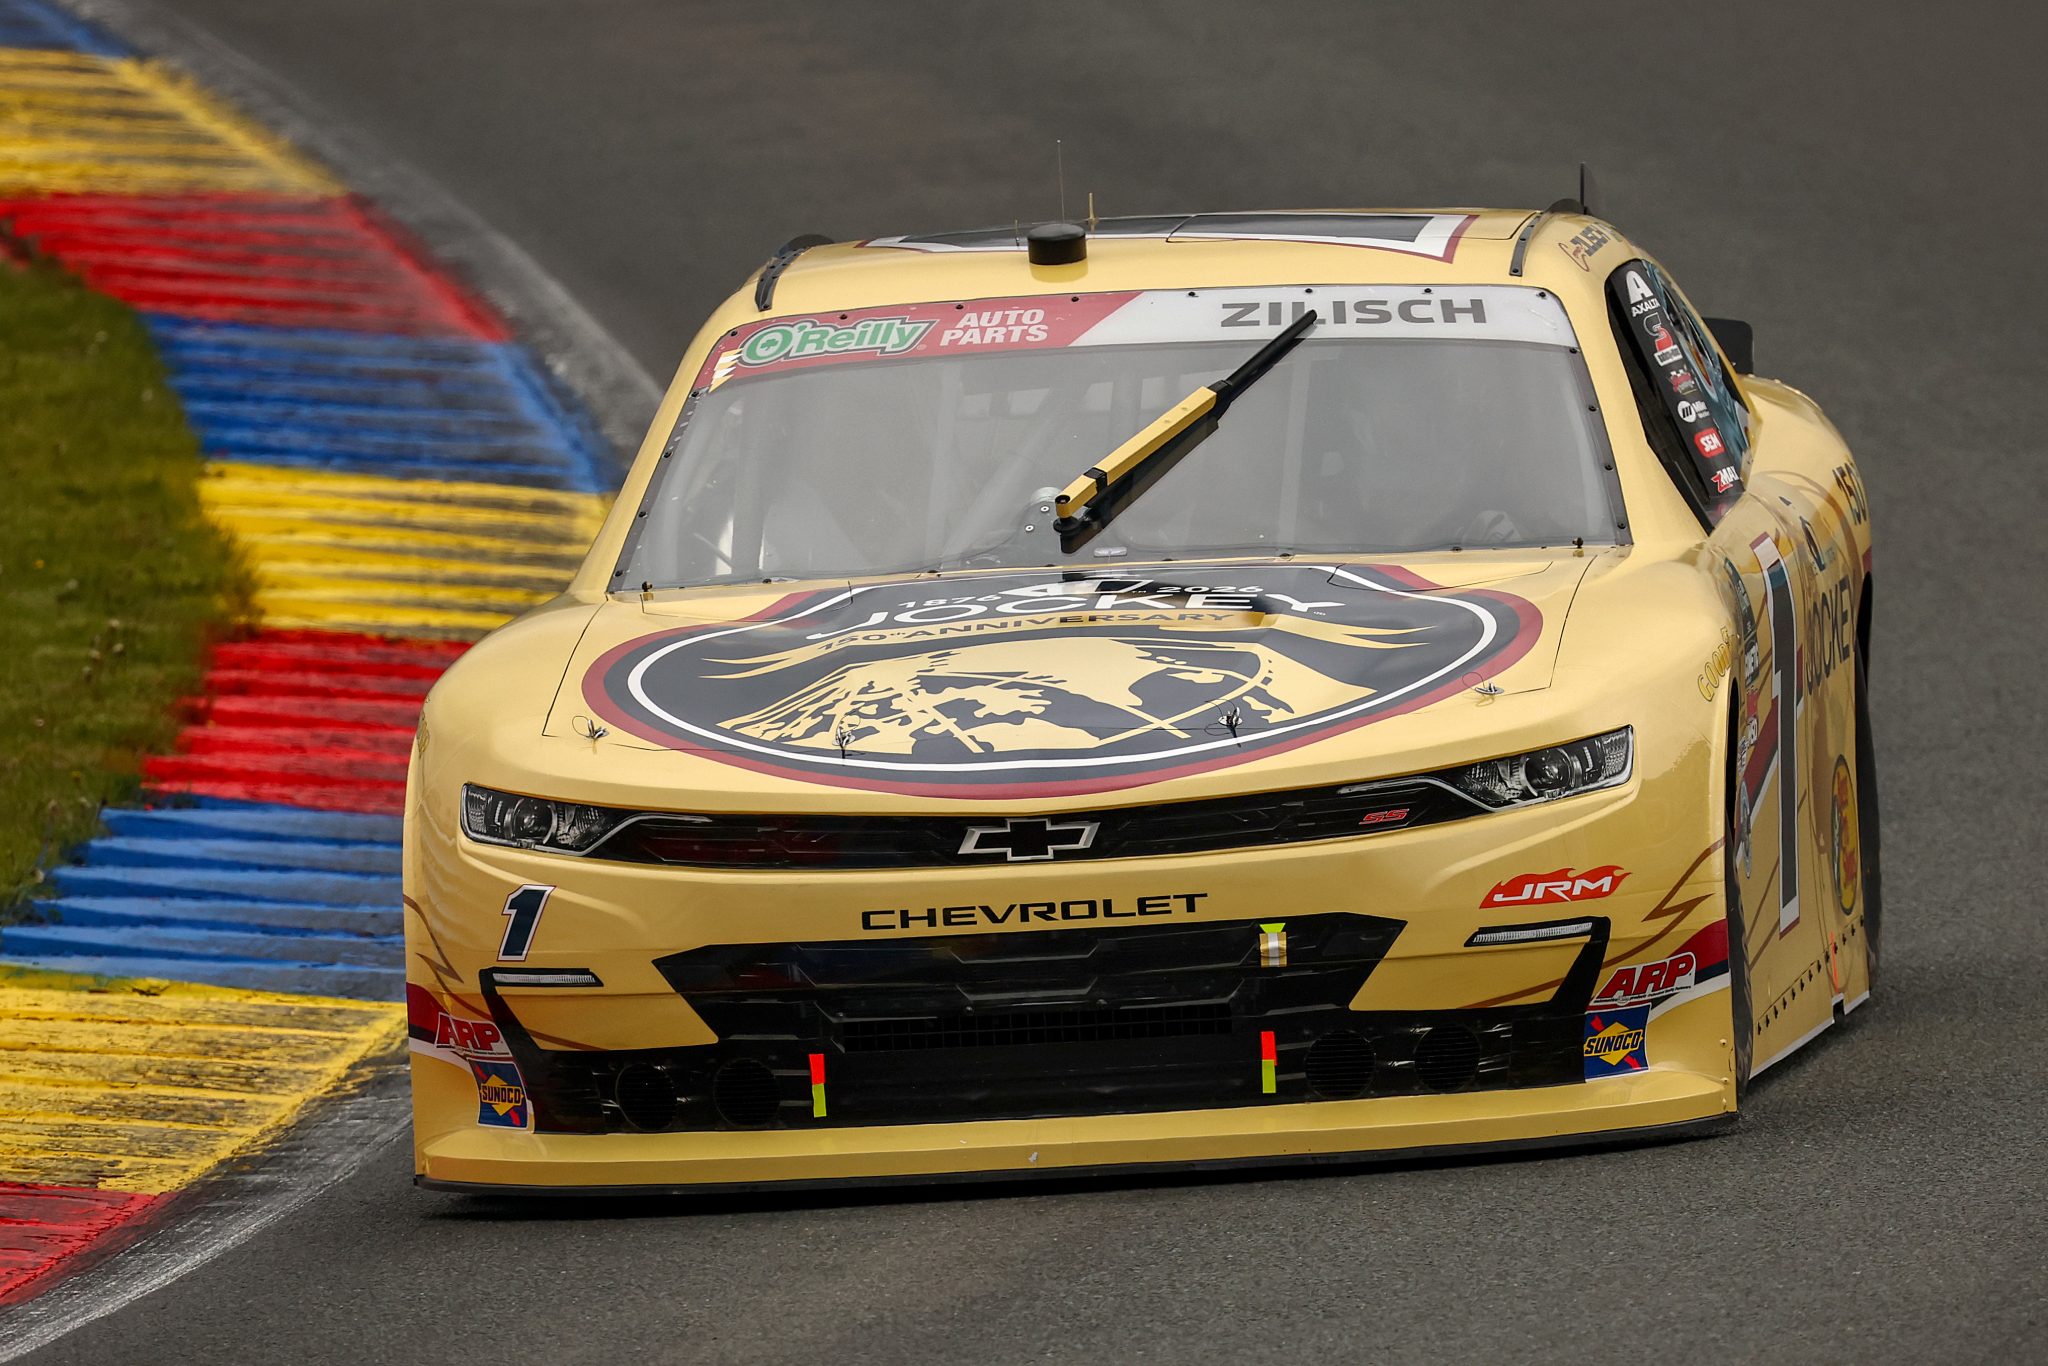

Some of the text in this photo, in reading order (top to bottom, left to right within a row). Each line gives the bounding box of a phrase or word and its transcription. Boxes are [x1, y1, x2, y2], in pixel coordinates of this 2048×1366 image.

[955, 308, 1045, 328] AUTO
[1220, 299, 1487, 328] ZILISCH
[1631, 298, 1661, 318] AXALTA
[741, 320, 931, 363] O'Reilly
[939, 323, 1049, 347] PARTS
[898, 594, 1002, 609] 1876
[1156, 585, 1264, 594] 2026
[805, 593, 1346, 640] JOCKEY
[904, 612, 1235, 639] ANNIVERSARY
[1357, 808, 1411, 826] SS
[1493, 875, 1613, 902] JRM
[496, 884, 557, 962] 1
[861, 892, 1209, 931] CHEVROLET
[1598, 954, 1694, 999] ARP
[437, 1013, 501, 1051] ARP
[1584, 1030, 1643, 1055] SUNOCO
[481, 1085, 522, 1105] SUNOCO
